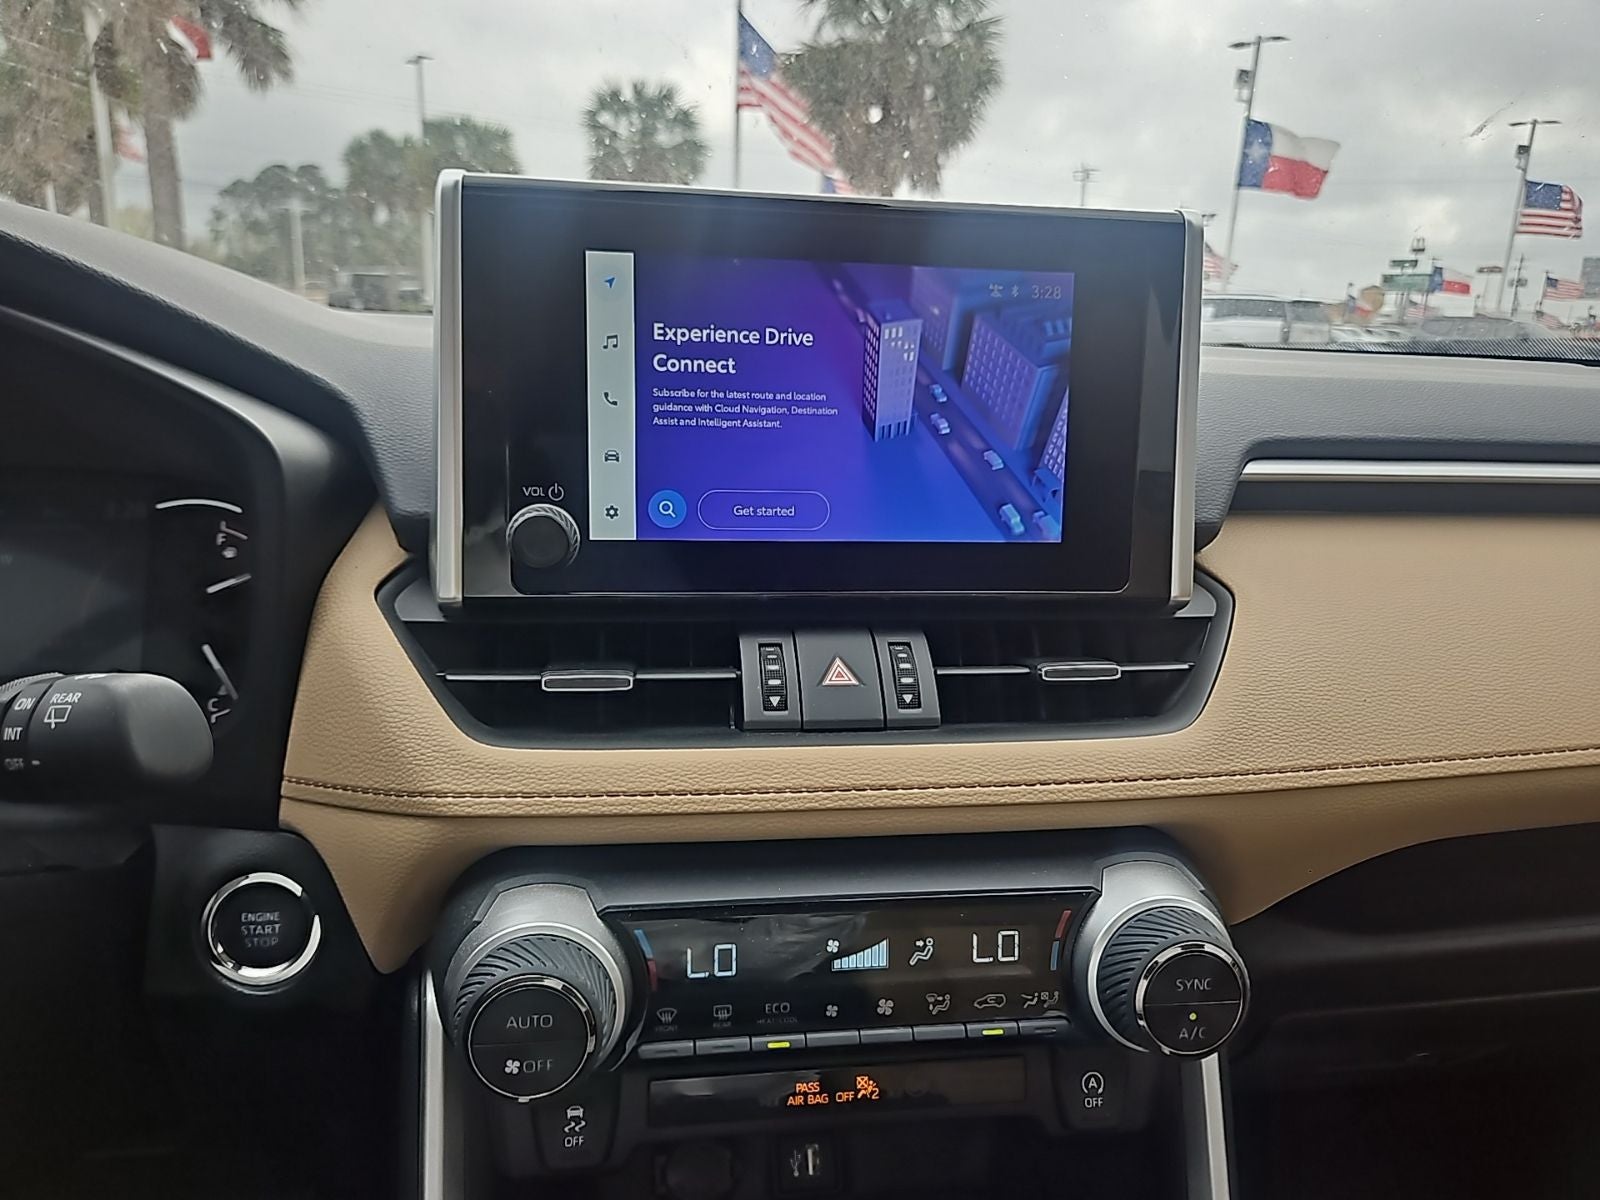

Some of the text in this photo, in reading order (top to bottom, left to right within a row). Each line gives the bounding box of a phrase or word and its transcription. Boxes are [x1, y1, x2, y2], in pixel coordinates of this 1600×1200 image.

[1031, 284, 1062, 300] 3:28
[652, 322, 814, 346] Experience Drive
[652, 353, 737, 374] Connect
[652, 387, 827, 402] Subscribe for the latest route and location
[652, 402, 838, 416] guidance with Cloud Navigation, Destination
[652, 416, 782, 430] Assist and Intelligent Assistant.
[522, 486, 545, 497] VOL
[732, 504, 795, 518] Get started
[14, 698, 36, 710] ON
[50, 692, 82, 704] REAR
[3, 727, 23, 740] INT
[241, 912, 280, 922] ENGINE
[241, 923, 281, 935] START
[244, 937, 279, 948] STOP
[972, 930, 1019, 963] LO
[686, 943, 737, 979] LO
[1175, 977, 1213, 991] SYNC
[765, 1002, 790, 1014] ECO
[506, 1014, 553, 1029] AUTO
[1179, 1026, 1206, 1040] A/C
[523, 1059, 553, 1073] OFF
[796, 1082, 820, 1093] PASS
[787, 1091, 855, 1106] AIR BAG OFF
[1084, 1097, 1104, 1108] OFF
[564, 1135, 584, 1147] OFF
